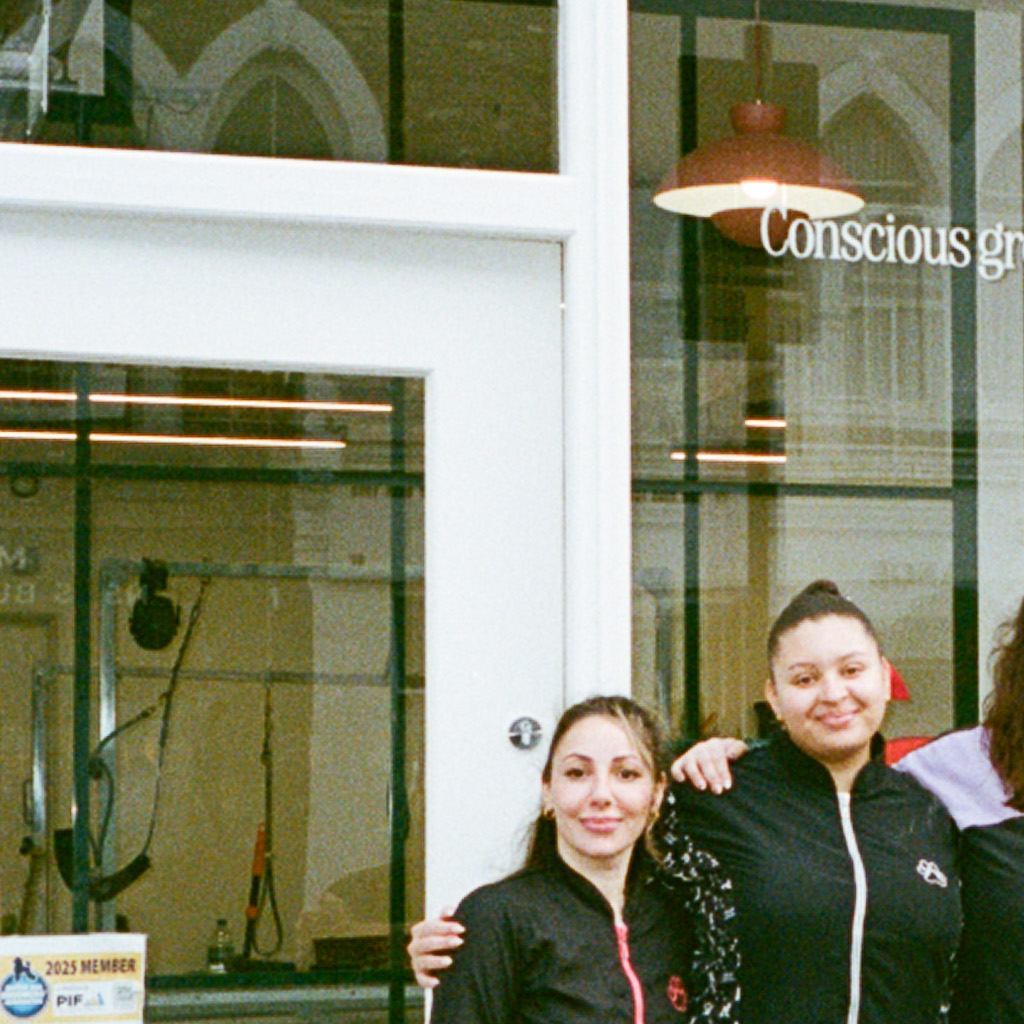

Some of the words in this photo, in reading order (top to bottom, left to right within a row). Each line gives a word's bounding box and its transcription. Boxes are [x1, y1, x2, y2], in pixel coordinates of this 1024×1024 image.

[760, 206, 971, 268] Conscious
[46, 960, 77, 975] 2025
[80, 958, 137, 975] MEMBER
[56, 994, 83, 1008] PIF
